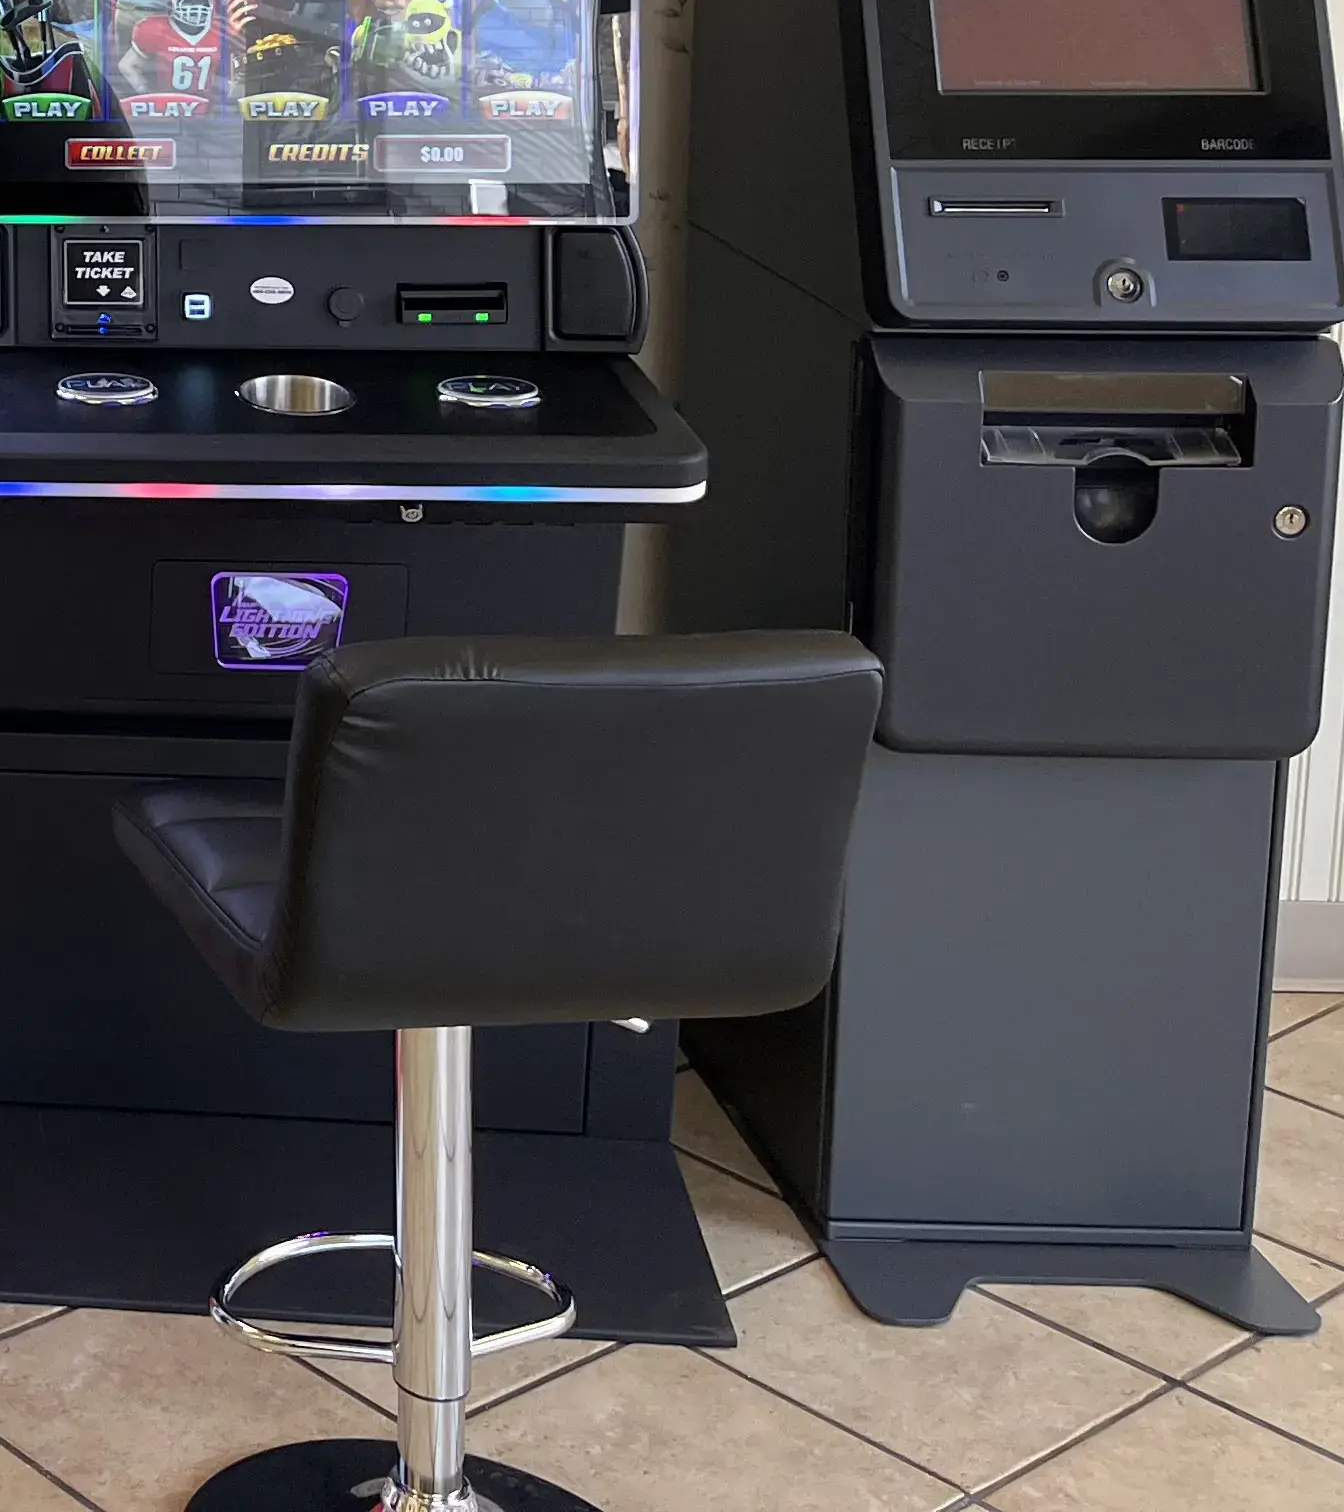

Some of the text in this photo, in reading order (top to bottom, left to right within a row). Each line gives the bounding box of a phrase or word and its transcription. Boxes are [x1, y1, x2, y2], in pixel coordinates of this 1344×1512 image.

[171, 55, 212, 91] 61
[13, 101, 84, 118] PLAY
[130, 101, 200, 118] PLAY
[248, 101, 321, 118] PLAY
[369, 101, 439, 117] PLAY
[490, 100, 561, 117] PLAY
[79, 144, 163, 162] COLLECT
[267, 144, 370, 163] CREDITS
[420, 146, 464, 164] $0.00
[83, 251, 126, 263] TAKE
[74, 267, 135, 279] TICKET
